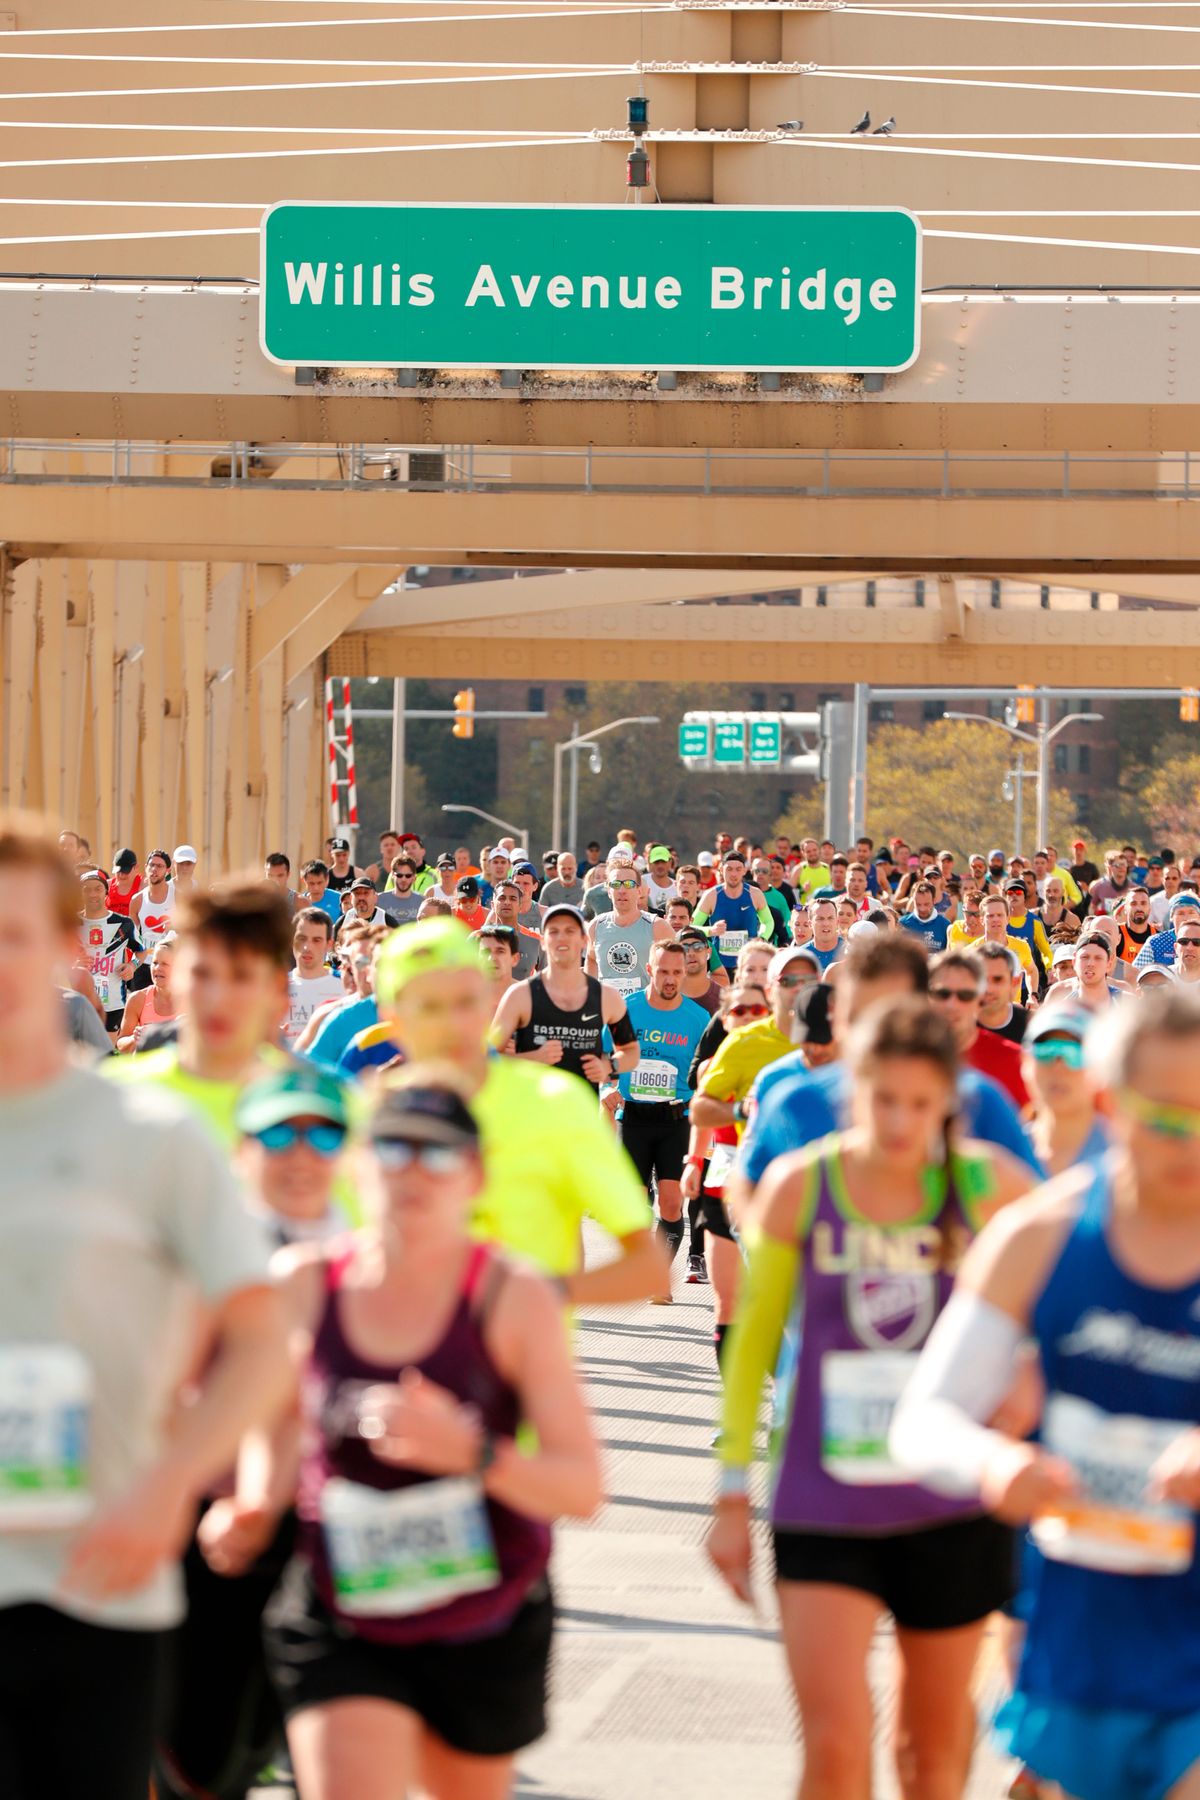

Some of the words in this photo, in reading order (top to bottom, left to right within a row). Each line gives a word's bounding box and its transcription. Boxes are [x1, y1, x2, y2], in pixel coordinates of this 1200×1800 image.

[284, 262, 435, 307] Willis
[464, 264, 682, 310] Avenue
[711, 266, 897, 326] Bridge
[92, 951, 116, 976] igi
[533, 1024, 599, 1038] EASTBOUND
[636, 1028, 688, 1047] ELGIUM
[639, 1072, 668, 1087] 18609
